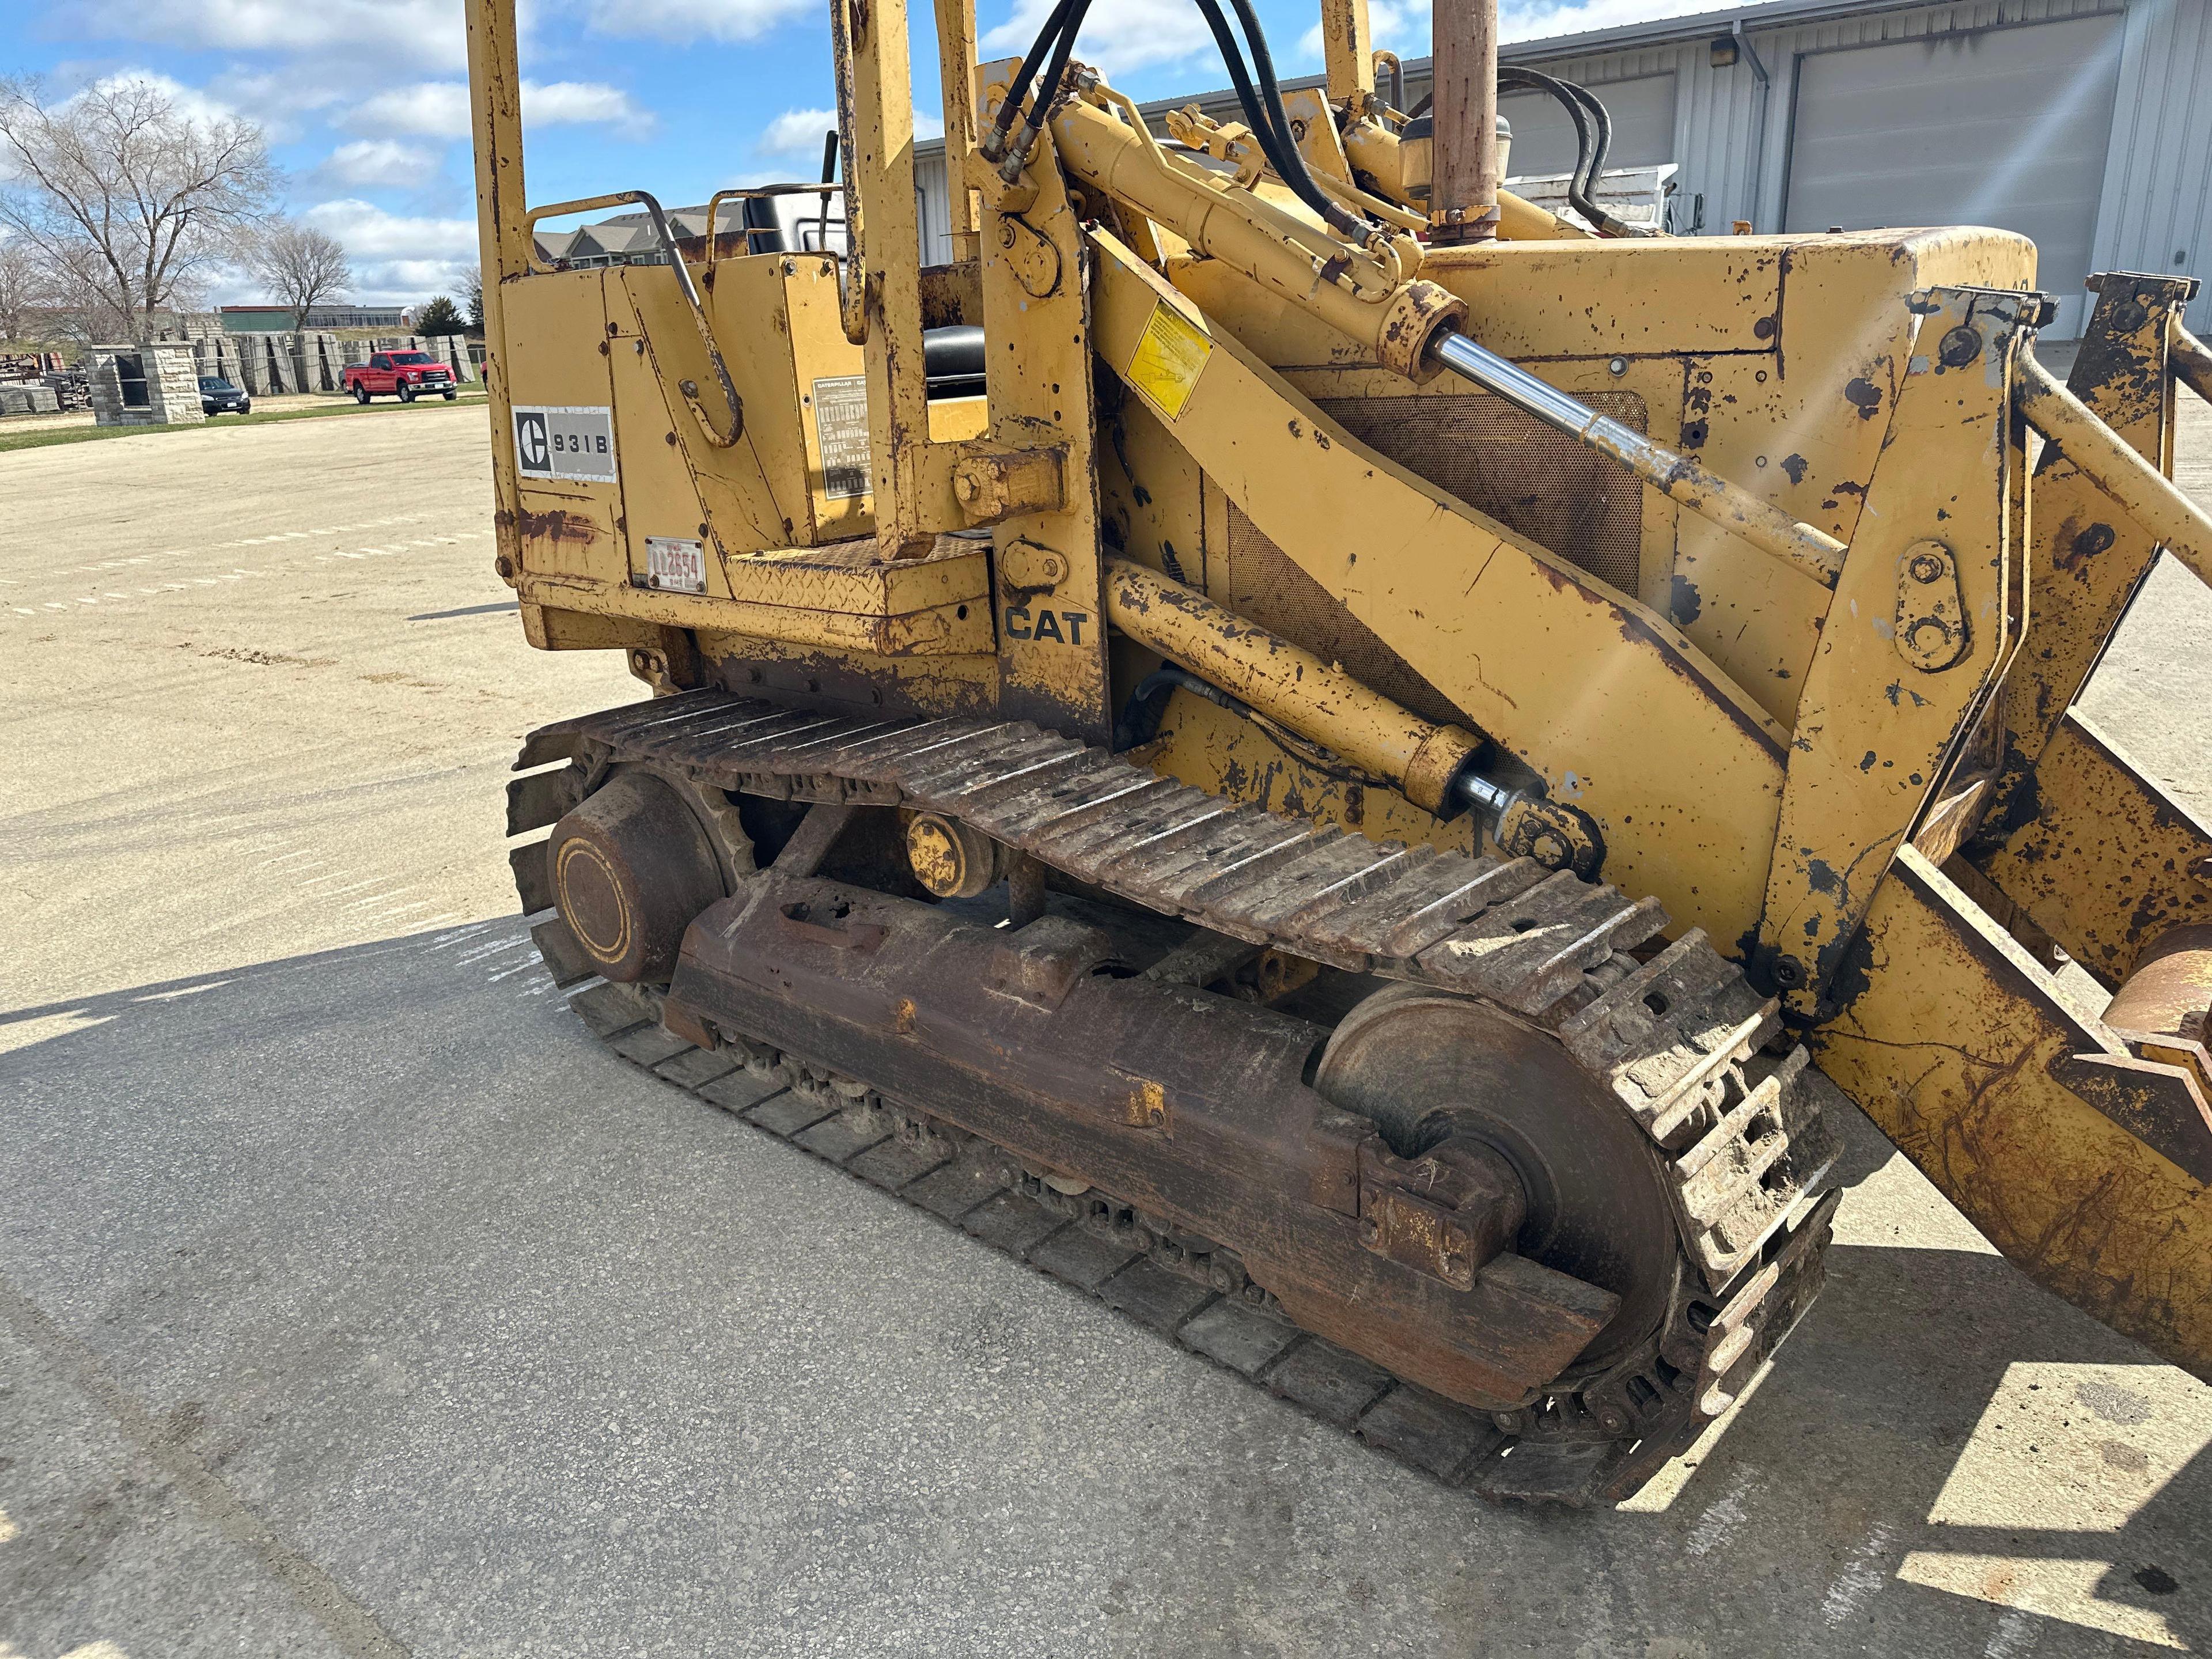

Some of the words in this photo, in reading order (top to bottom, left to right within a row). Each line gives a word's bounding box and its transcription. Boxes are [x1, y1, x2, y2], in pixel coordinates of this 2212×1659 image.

[554, 434, 608, 454] 931B
[652, 551, 698, 578] LL2654
[1005, 607, 1088, 646] CAT
